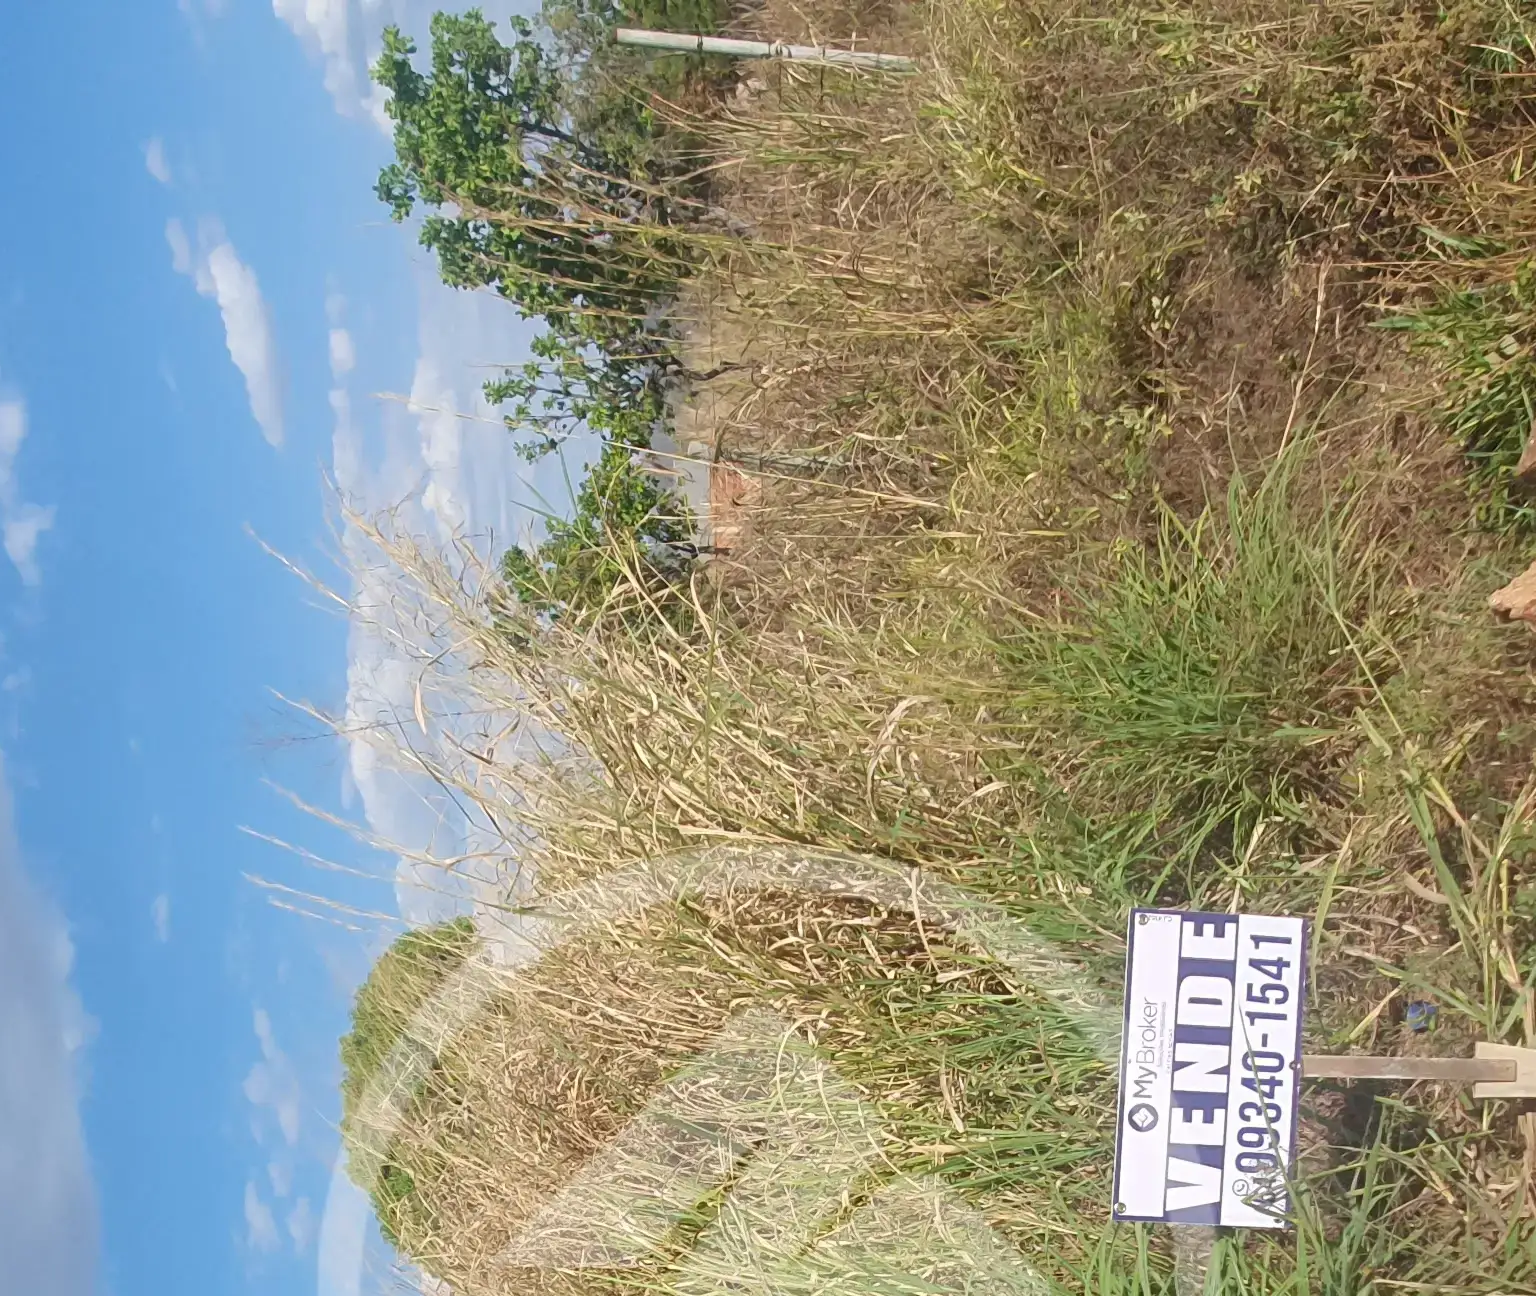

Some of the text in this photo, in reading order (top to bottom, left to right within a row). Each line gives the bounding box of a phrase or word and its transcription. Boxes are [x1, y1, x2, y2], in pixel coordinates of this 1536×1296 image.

[1133, 997, 1158, 1099] MyBroker
[1166, 921, 1237, 1211] VENDE
[1236, 934, 1292, 1173] 99340-1541
